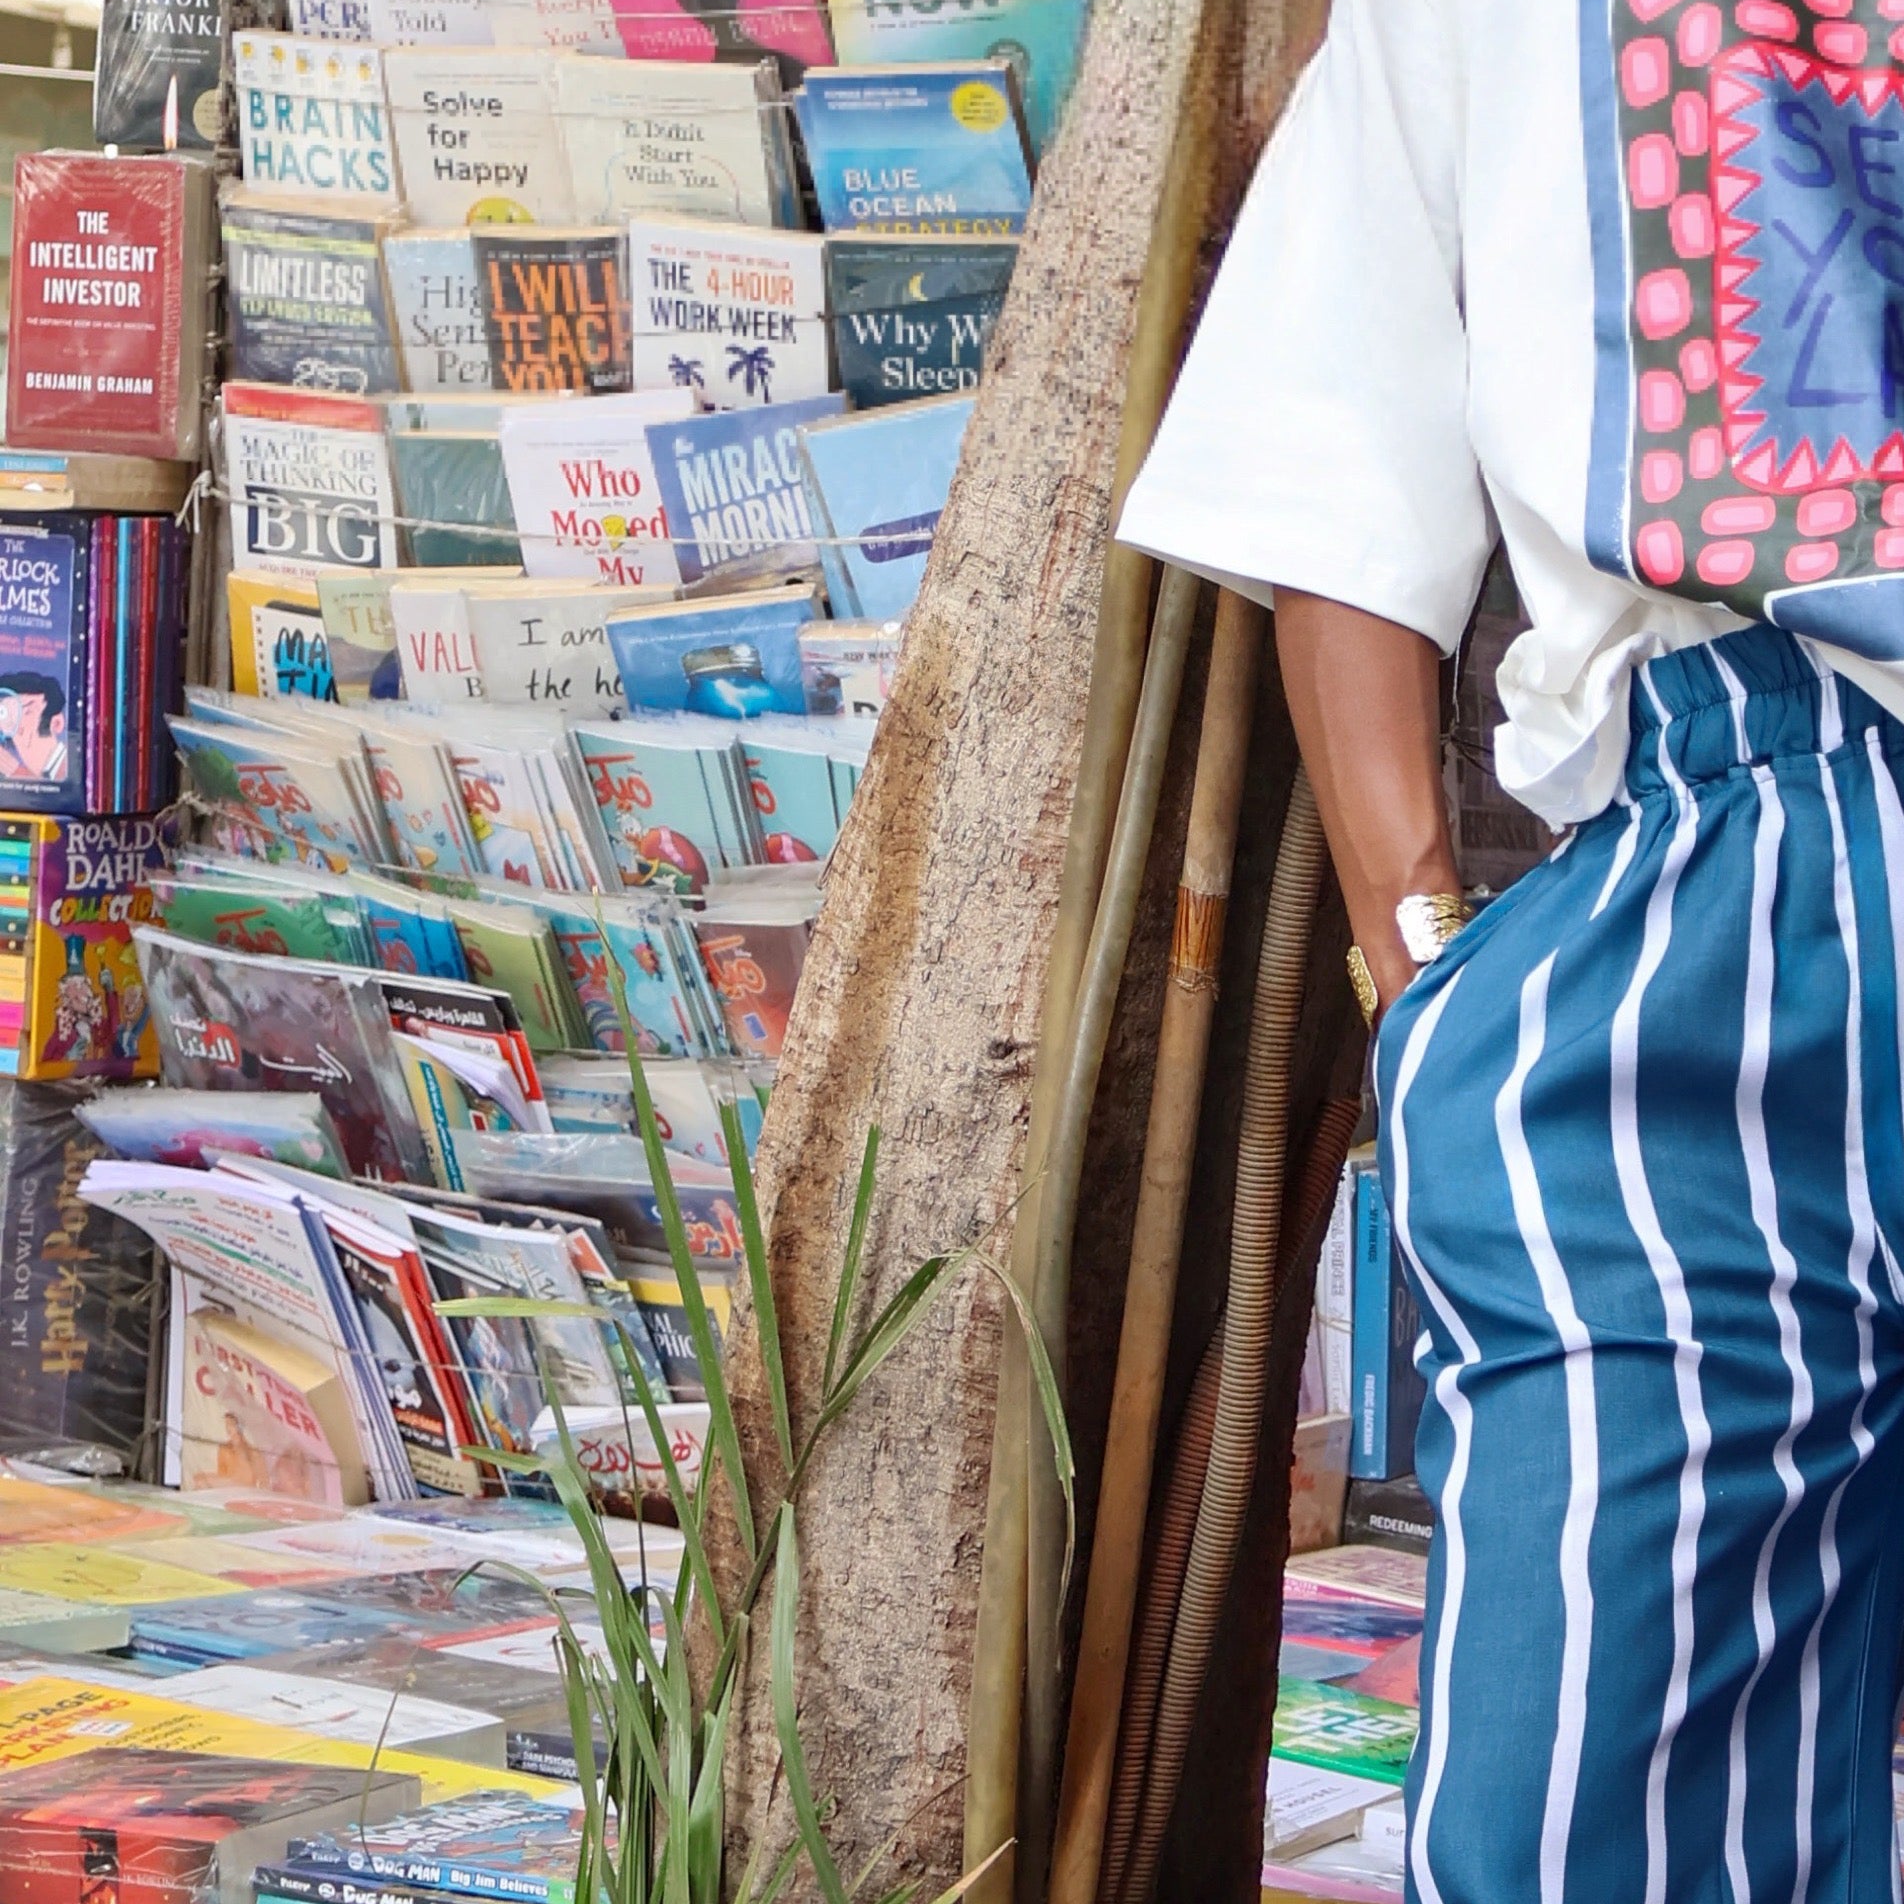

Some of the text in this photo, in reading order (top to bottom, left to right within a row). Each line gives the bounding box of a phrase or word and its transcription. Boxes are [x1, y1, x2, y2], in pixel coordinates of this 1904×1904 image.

[249, 87, 383, 143] BRAIN
[423, 90, 504, 118] Solve
[427, 123, 472, 149] for
[250, 138, 390, 193] HACKS
[639, 143, 693, 165] Start
[433, 156, 529, 189] Happy
[624, 164, 677, 187] With
[843, 168, 922, 193] BLUE
[848, 192, 957, 219] OCEAN
[76, 210, 111, 235] THE
[29, 241, 159, 274] INTELLIGENT
[42, 277, 142, 308] INVESTOR
[240, 250, 368, 305] LIMITLESS
[647, 256, 694, 294] THE
[706, 268, 795, 307] 4-HOUR
[850, 314, 937, 355] Why
[25, 371, 154, 395] BENJAMIN GRAHAM
[880, 356, 979, 392] Sleep
[240, 434, 332, 467] MAGIC
[240, 458, 378, 497] THINKING
[558, 458, 642, 499] Who
[251, 491, 380, 565] BIG
[0, 557, 61, 587] RLOCK
[561, 626, 604, 647] am
[526, 668, 573, 701] the
[66, 820, 156, 854] ROALD
[259, 1042, 353, 1085] البيت
[14, 1176, 39, 1301] ROWLING
[41, 1264, 89, 1374] Harry
[1368, 1513, 1434, 1540] REDEEMING
[370, 1855, 405, 1878] DOG
[407, 1861, 441, 1883] MAN
[450, 1869, 472, 1889] Big
[474, 1872, 497, 1892] Jim
[499, 1877, 549, 1898] Believes
